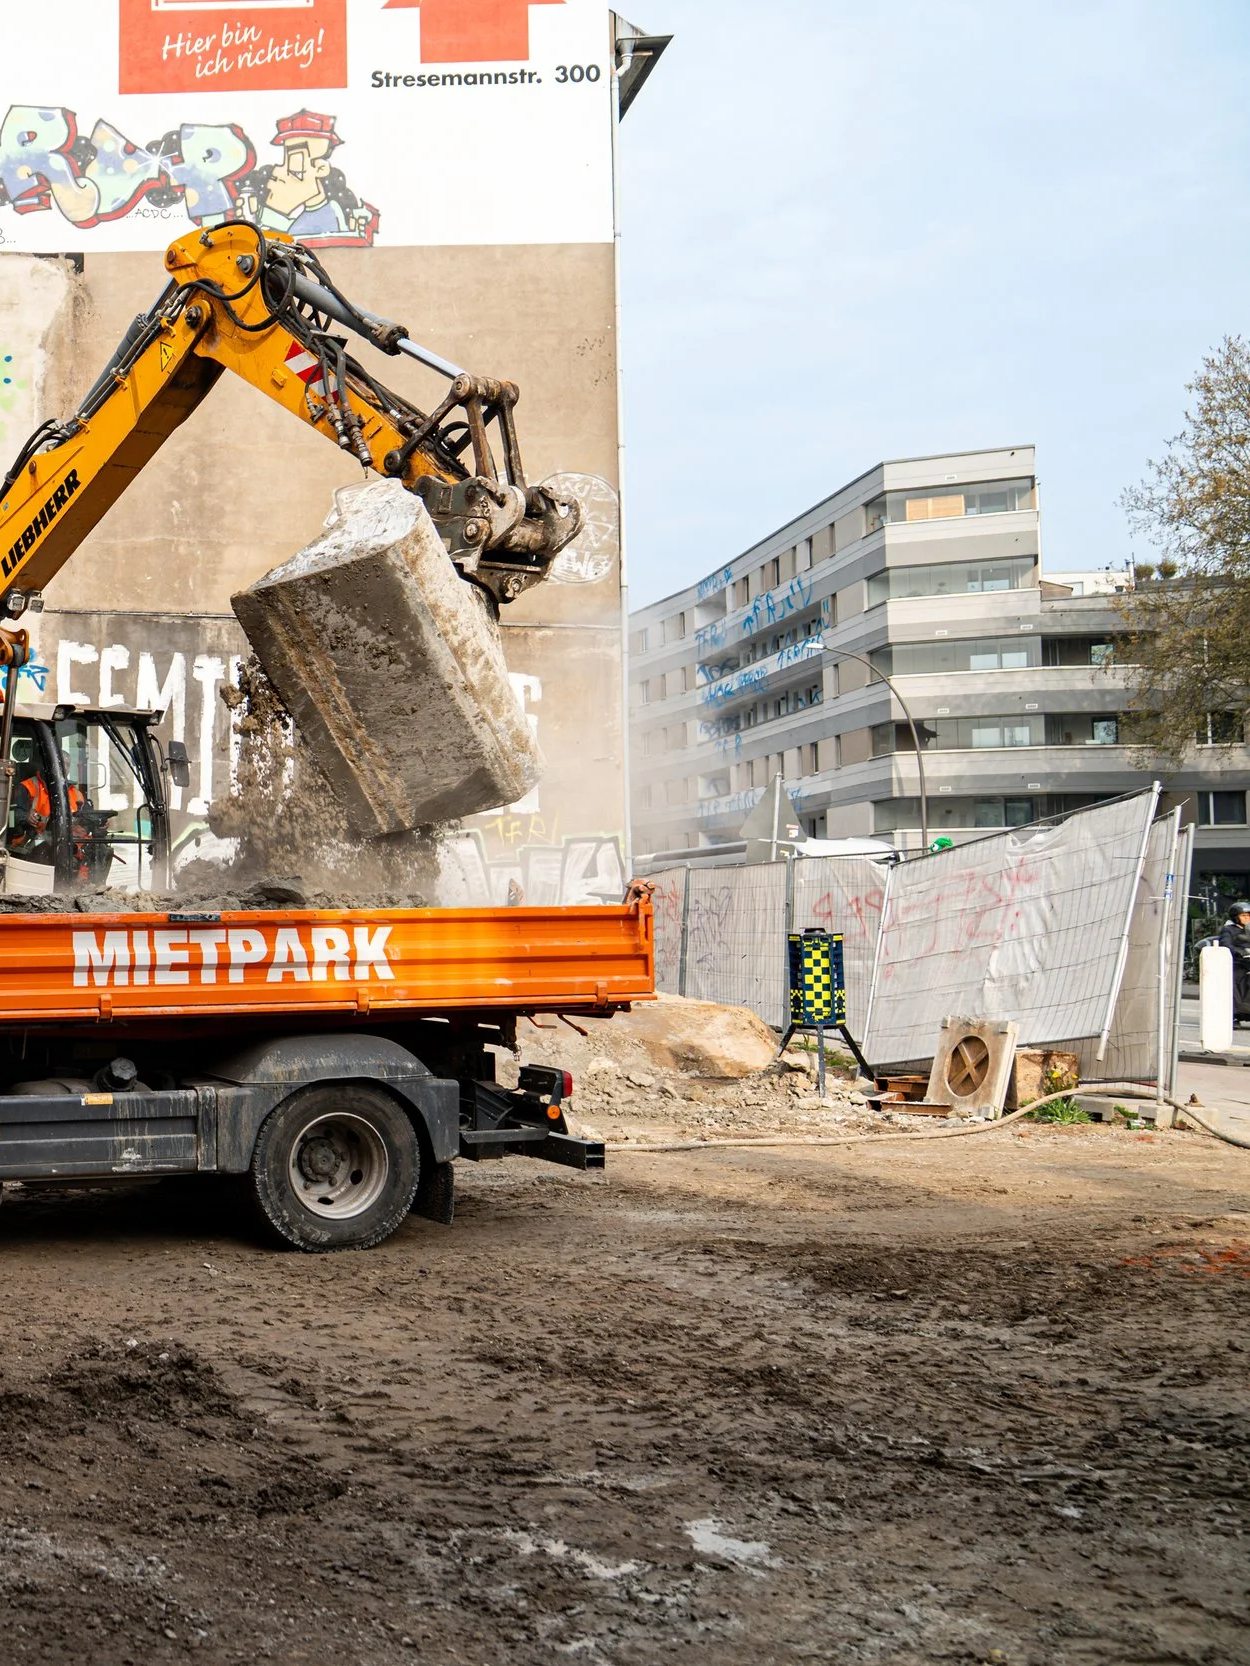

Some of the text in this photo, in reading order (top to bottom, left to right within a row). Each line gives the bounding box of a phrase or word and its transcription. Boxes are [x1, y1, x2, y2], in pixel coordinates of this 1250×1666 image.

[161, 22, 263, 61] Hier bin
[195, 28, 325, 78] ich richtig!
[370, 64, 601, 88] Stresemannstr. 300
[0, 468, 82, 579] LIEBHERR
[72, 926, 395, 987] MIETPARK
